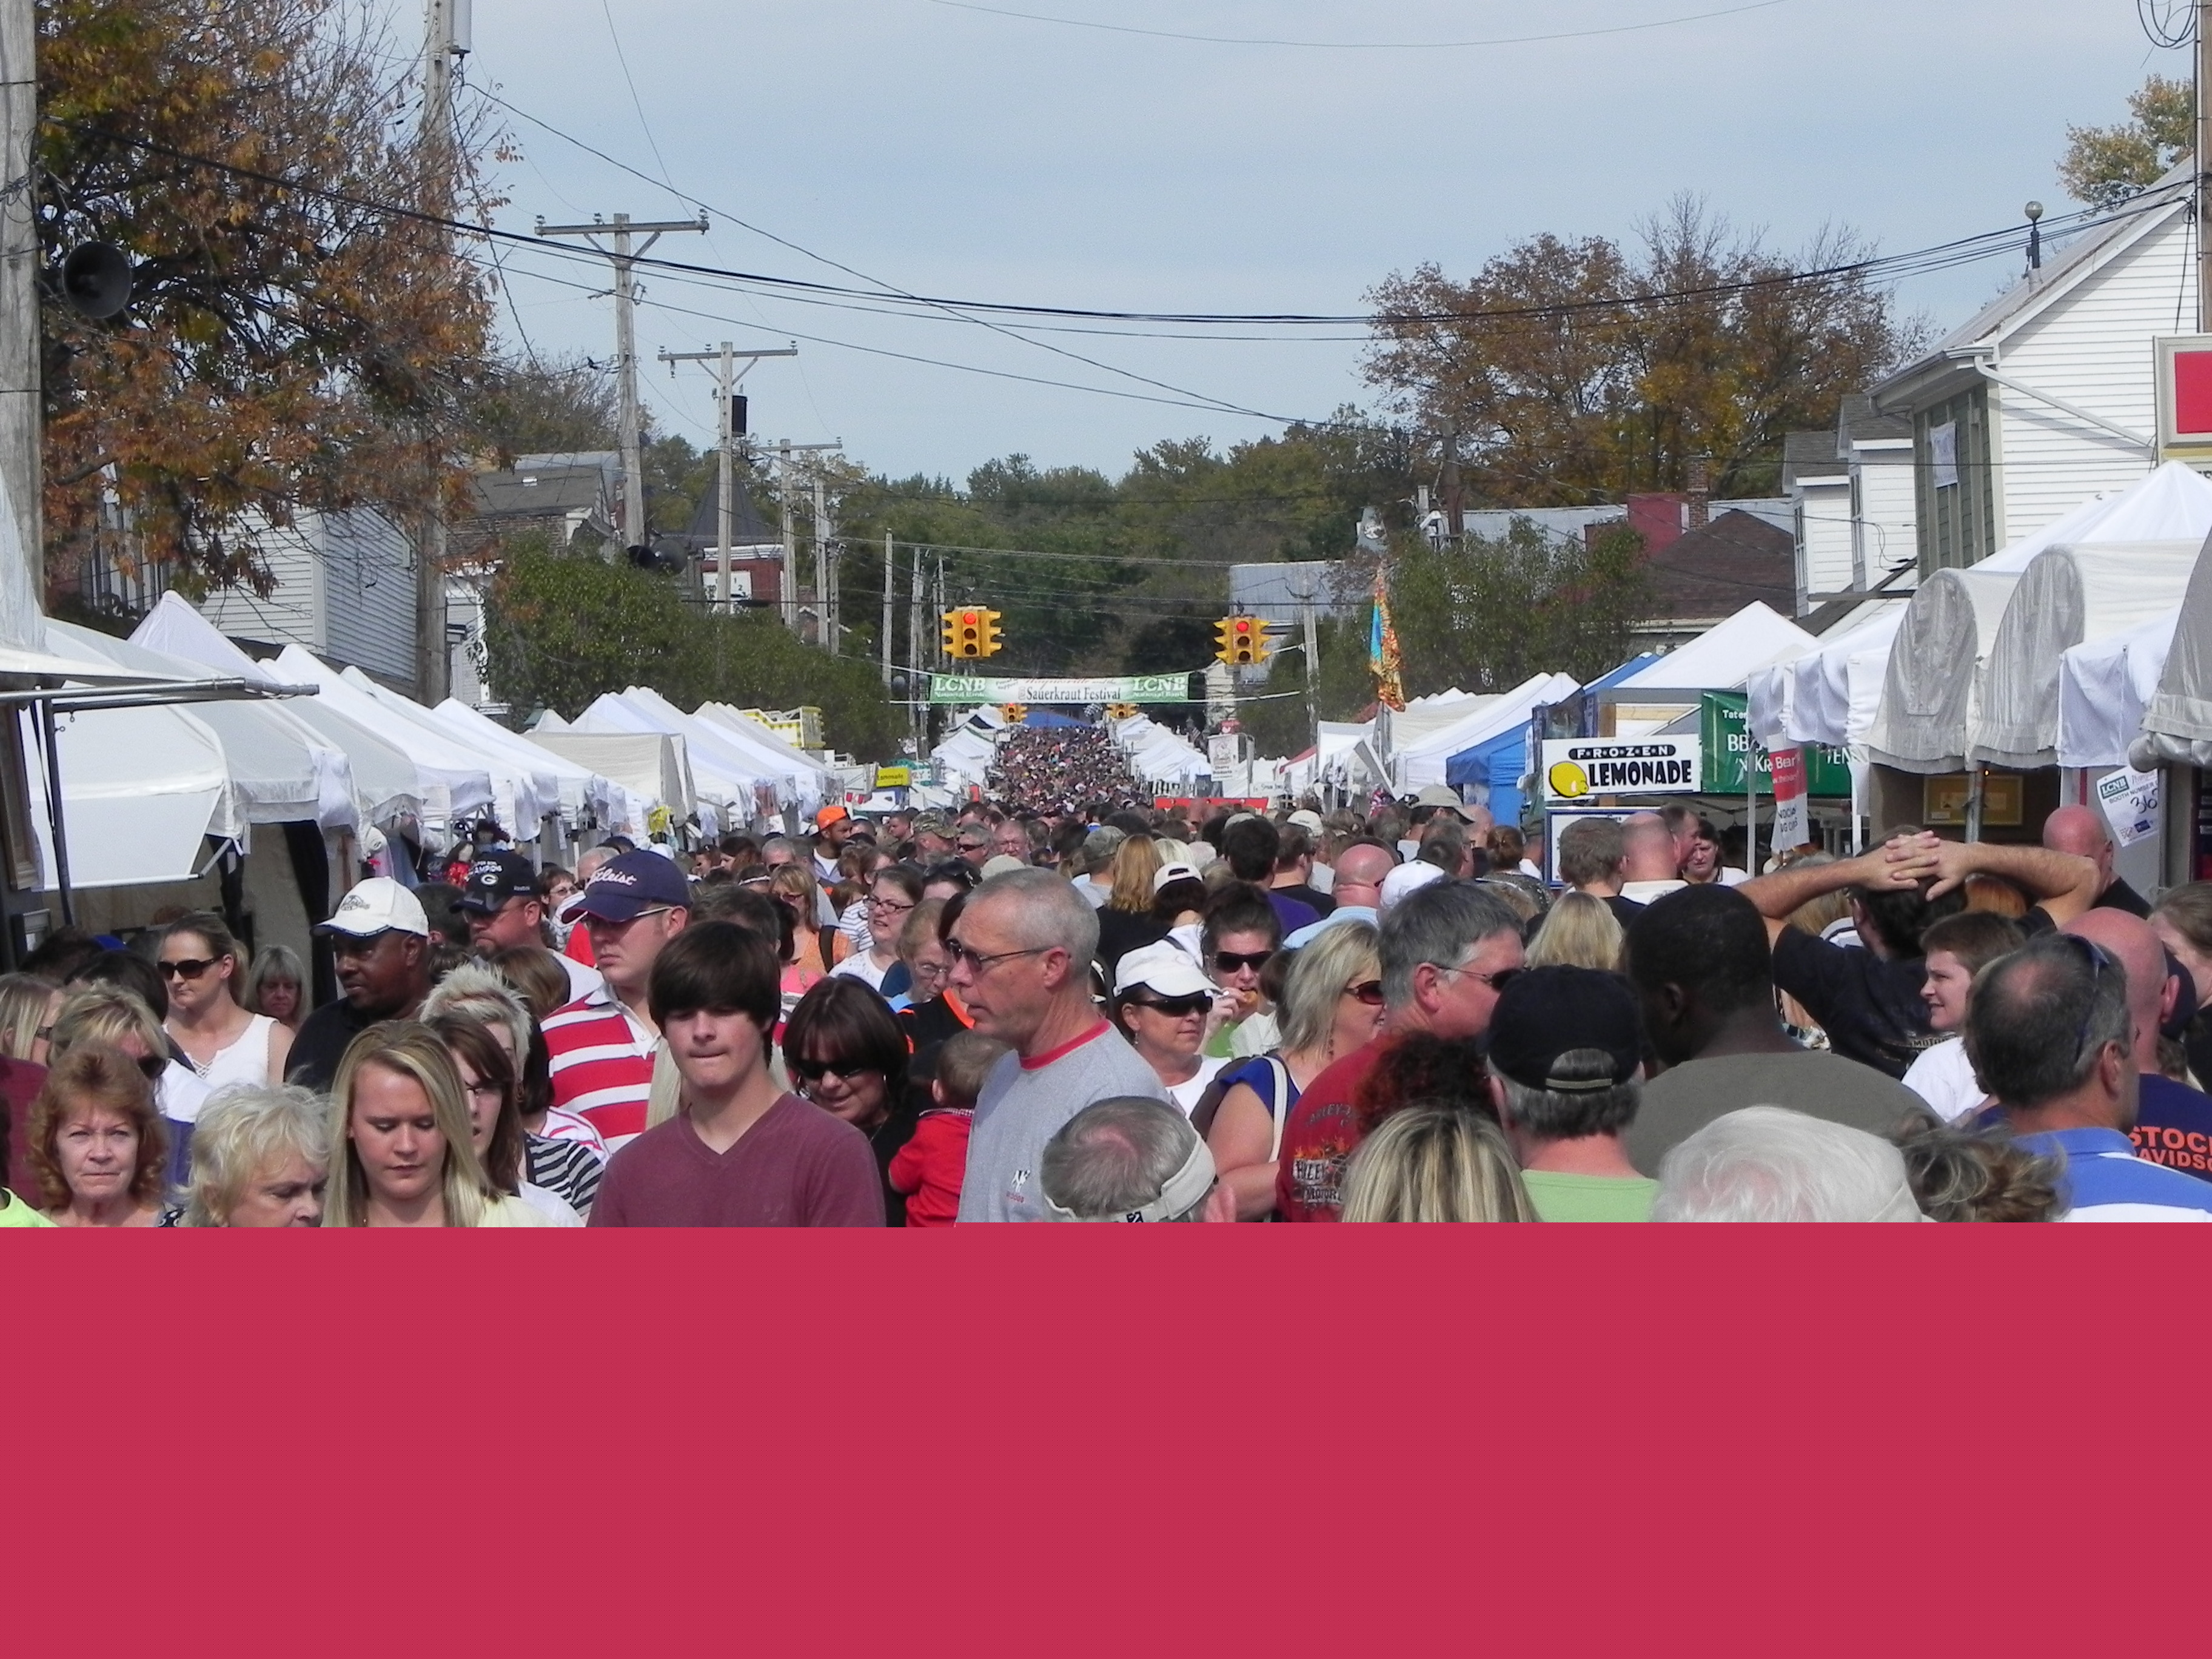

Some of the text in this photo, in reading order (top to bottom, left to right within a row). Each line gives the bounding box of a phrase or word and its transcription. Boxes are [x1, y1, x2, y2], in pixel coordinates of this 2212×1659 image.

[934, 677, 986, 692] LCNB
[1132, 676, 1186, 692] LCNB
[1027, 686, 1121, 700] Sauerkraut Festival
[1588, 759, 1692, 788] LEMONADE
[2101, 779, 2127, 793] LCNB
[2109, 782, 2154, 804] BOOTH NUMBER
[481, 874, 497, 885] G
